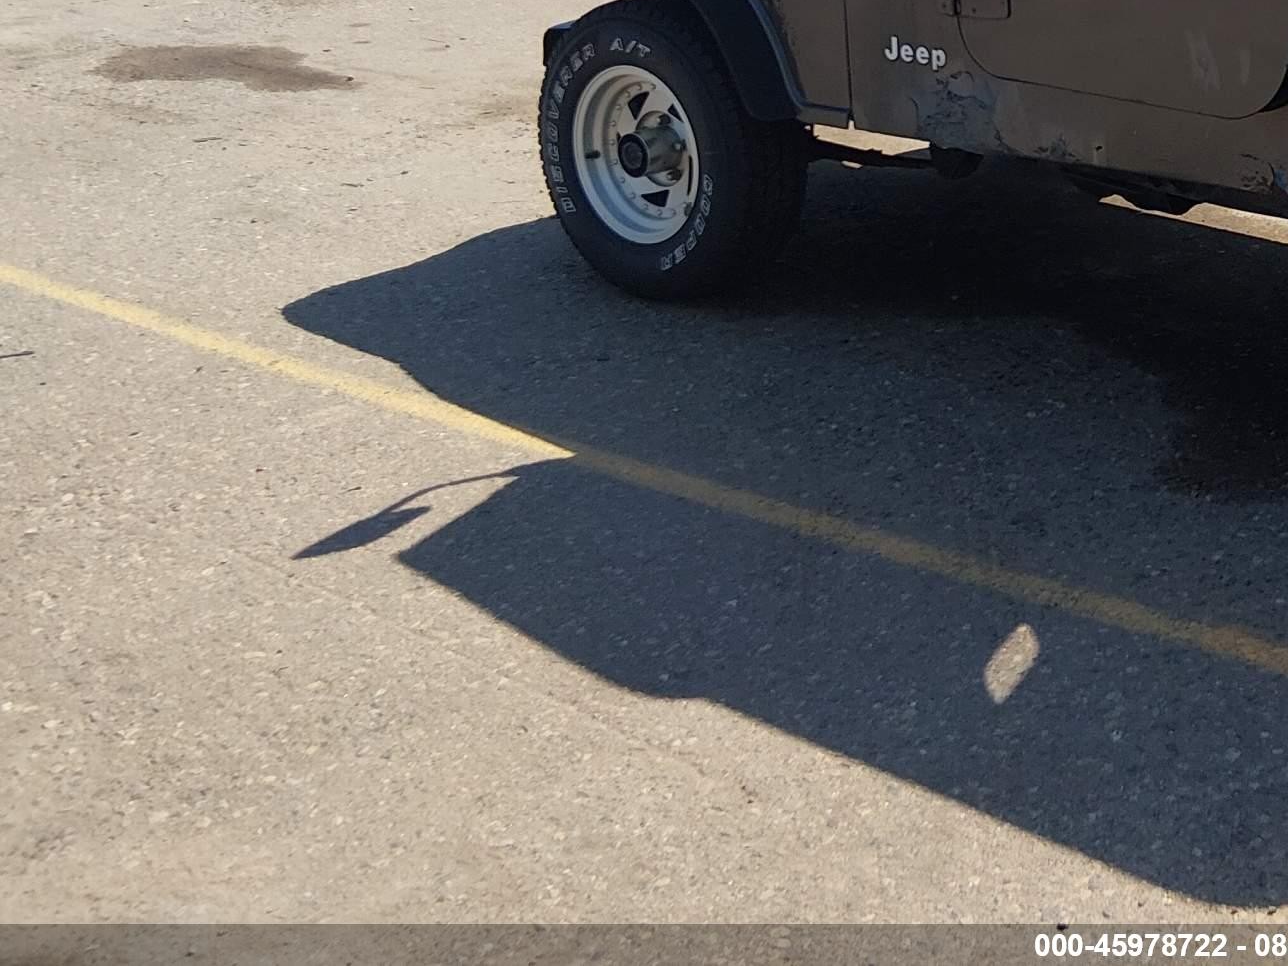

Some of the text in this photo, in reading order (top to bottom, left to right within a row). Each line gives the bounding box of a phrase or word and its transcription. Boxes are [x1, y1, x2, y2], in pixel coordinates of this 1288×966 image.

[609, 37, 651, 58] A/T
[884, 35, 946, 71] Jeep
[660, 173, 713, 271] COOPER
